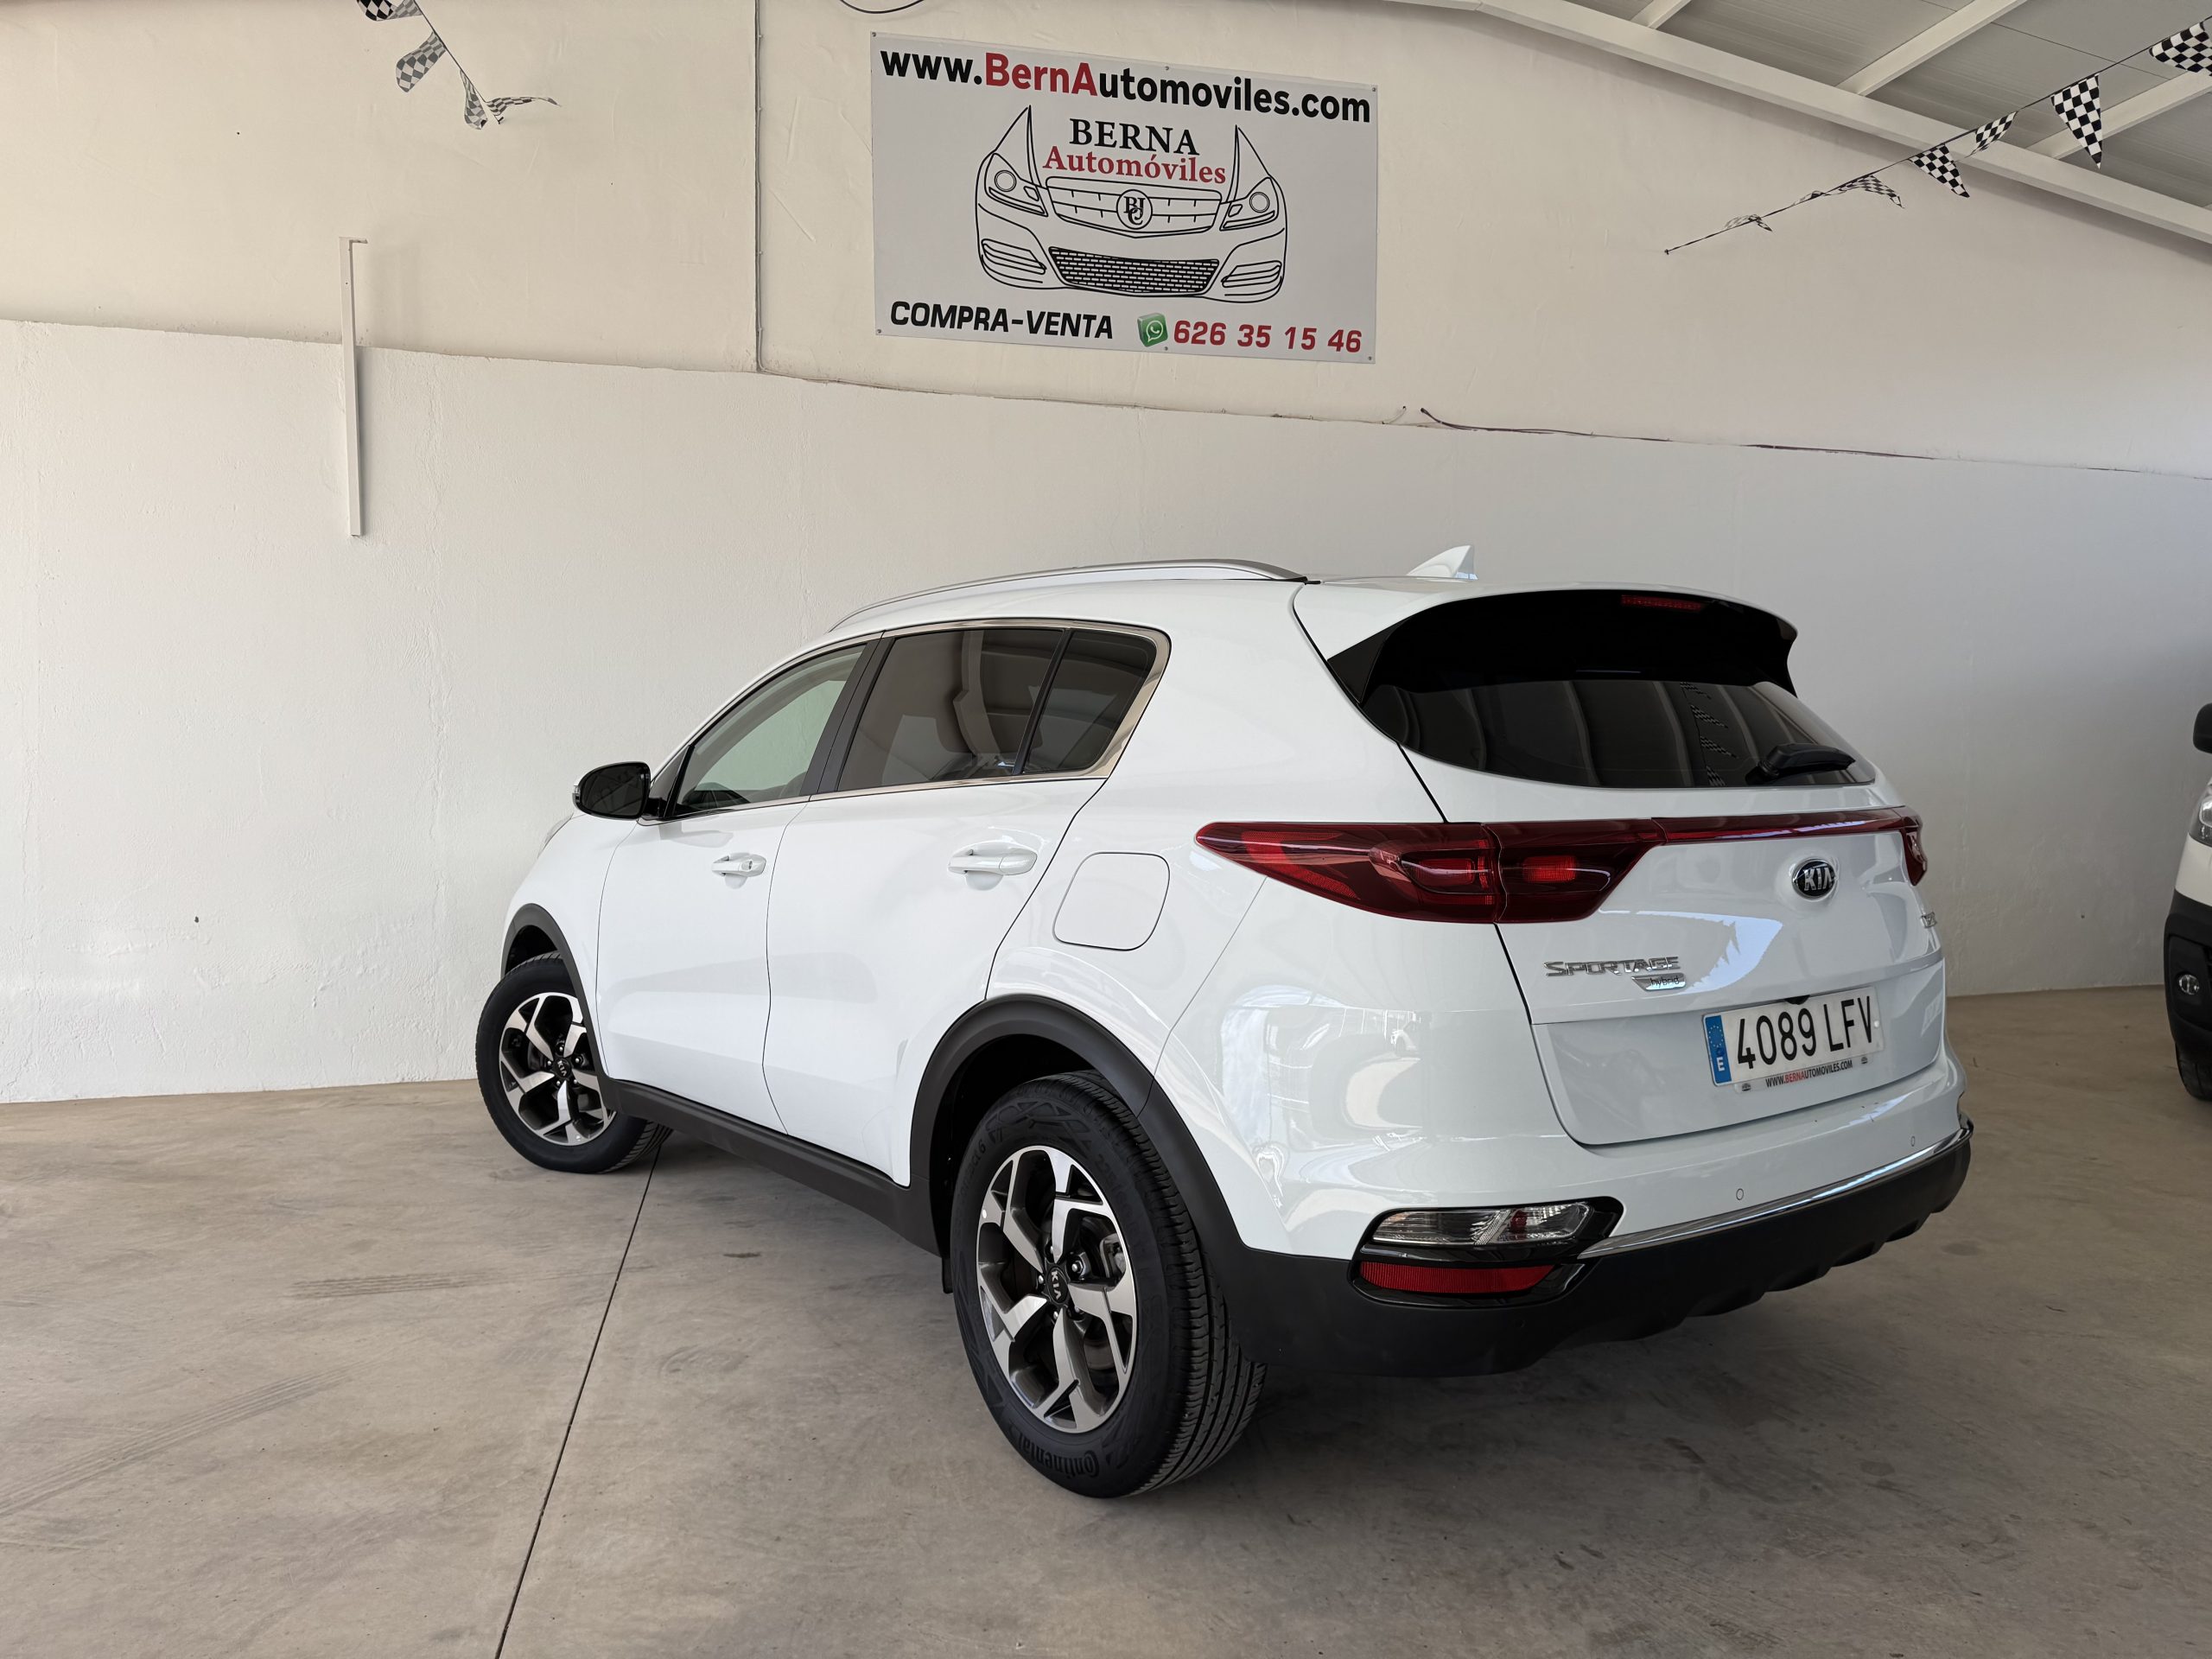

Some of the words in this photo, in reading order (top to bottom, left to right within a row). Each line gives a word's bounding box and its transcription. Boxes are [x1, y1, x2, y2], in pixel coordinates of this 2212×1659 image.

[880, 50, 1370, 123] www.BernAutomoviles.com
[1069, 118, 1200, 156] BERNA
[1042, 145, 1226, 184] Automóviles
[890, 301, 1113, 340] COMPRA-VENTA
[1173, 320, 1227, 346] 626
[1236, 323, 1272, 348] 35
[1284, 326, 1318, 351] 15
[1327, 329, 1363, 353] 46
[1803, 867, 1833, 892] KIA
[1544, 956, 1681, 976] SPORTAGE
[1649, 976, 1680, 989] hybrid
[1738, 1007, 1816, 1070] 4089
[1823, 995, 1872, 1052] LFV
[557, 1060, 568, 1077] KIA
[1716, 1056, 1726, 1071] E
[1765, 1059, 1853, 1088] WWW.BERNAUTOMOVILES.COM
[1051, 1270, 1062, 1300] KIA
[1019, 1432, 1100, 1479] Continental
